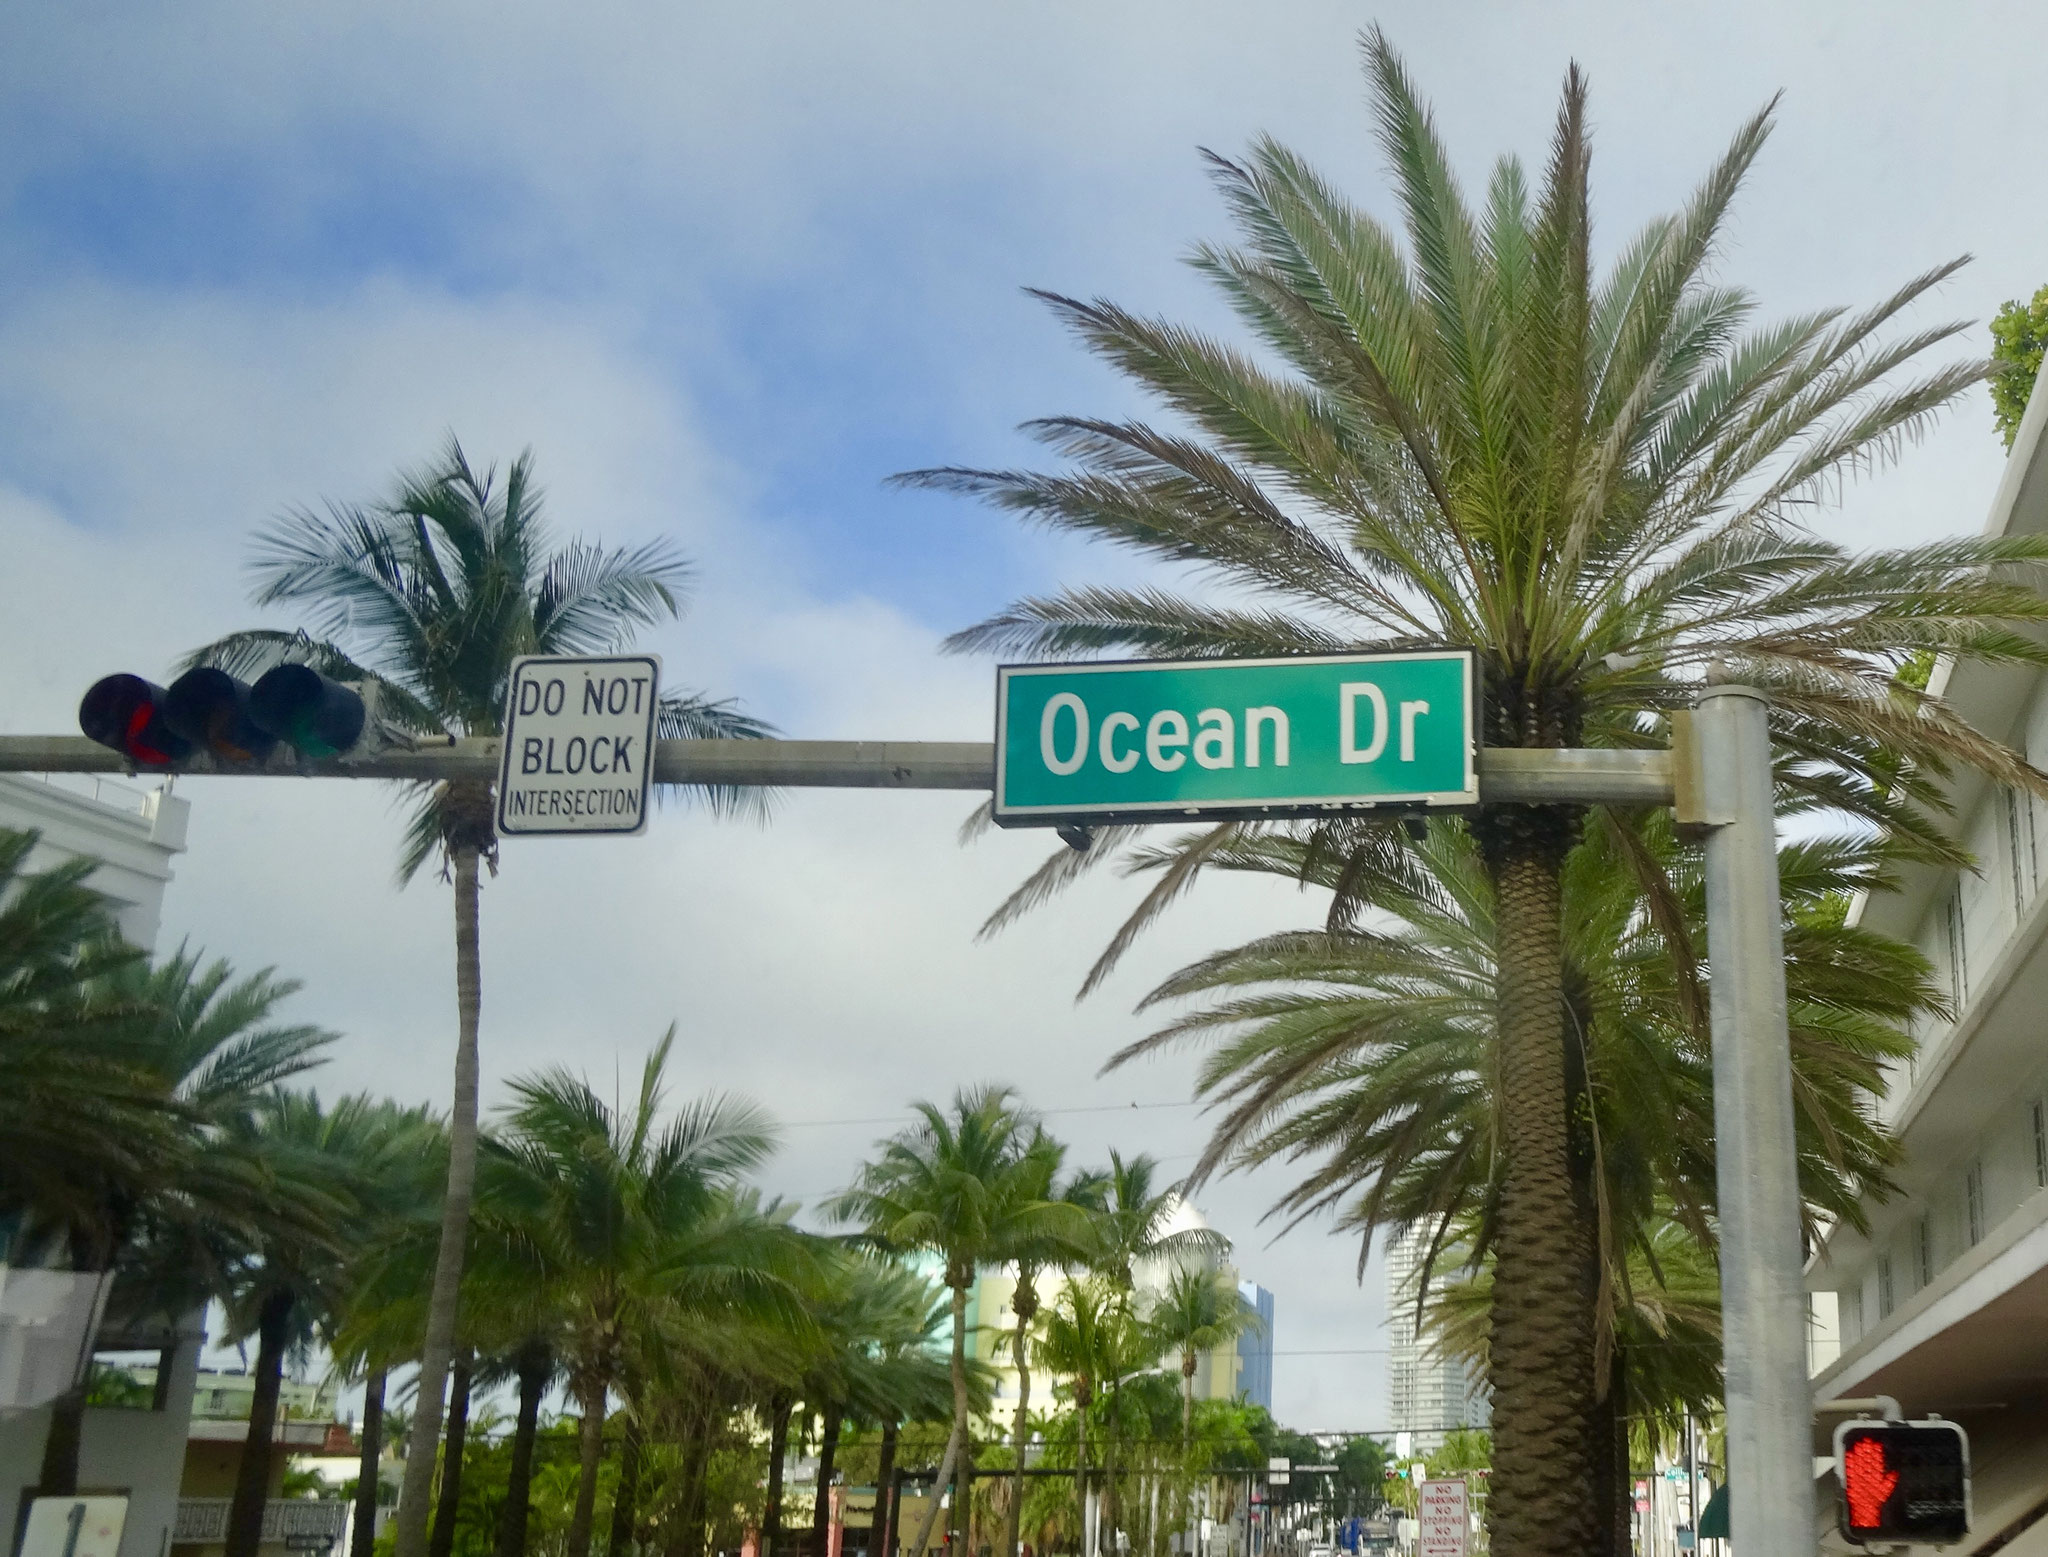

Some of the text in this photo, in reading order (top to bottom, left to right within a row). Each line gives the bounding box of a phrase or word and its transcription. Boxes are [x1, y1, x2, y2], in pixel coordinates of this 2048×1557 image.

[519, 677, 649, 716] DO NOT
[1040, 682, 1430, 776] Ocean Dr
[522, 736, 633, 775] BLOCK
[508, 788, 639, 816] INTERSECTION
[1436, 1485, 1452, 1494] NO
[1425, 1496, 1461, 1505] PARKING
[1435, 1506, 1452, 1515] NO
[1423, 1516, 1462, 1525] STOPPING
[1435, 1527, 1451, 1536] NO
[1423, 1537, 1462, 1546] STANDING
